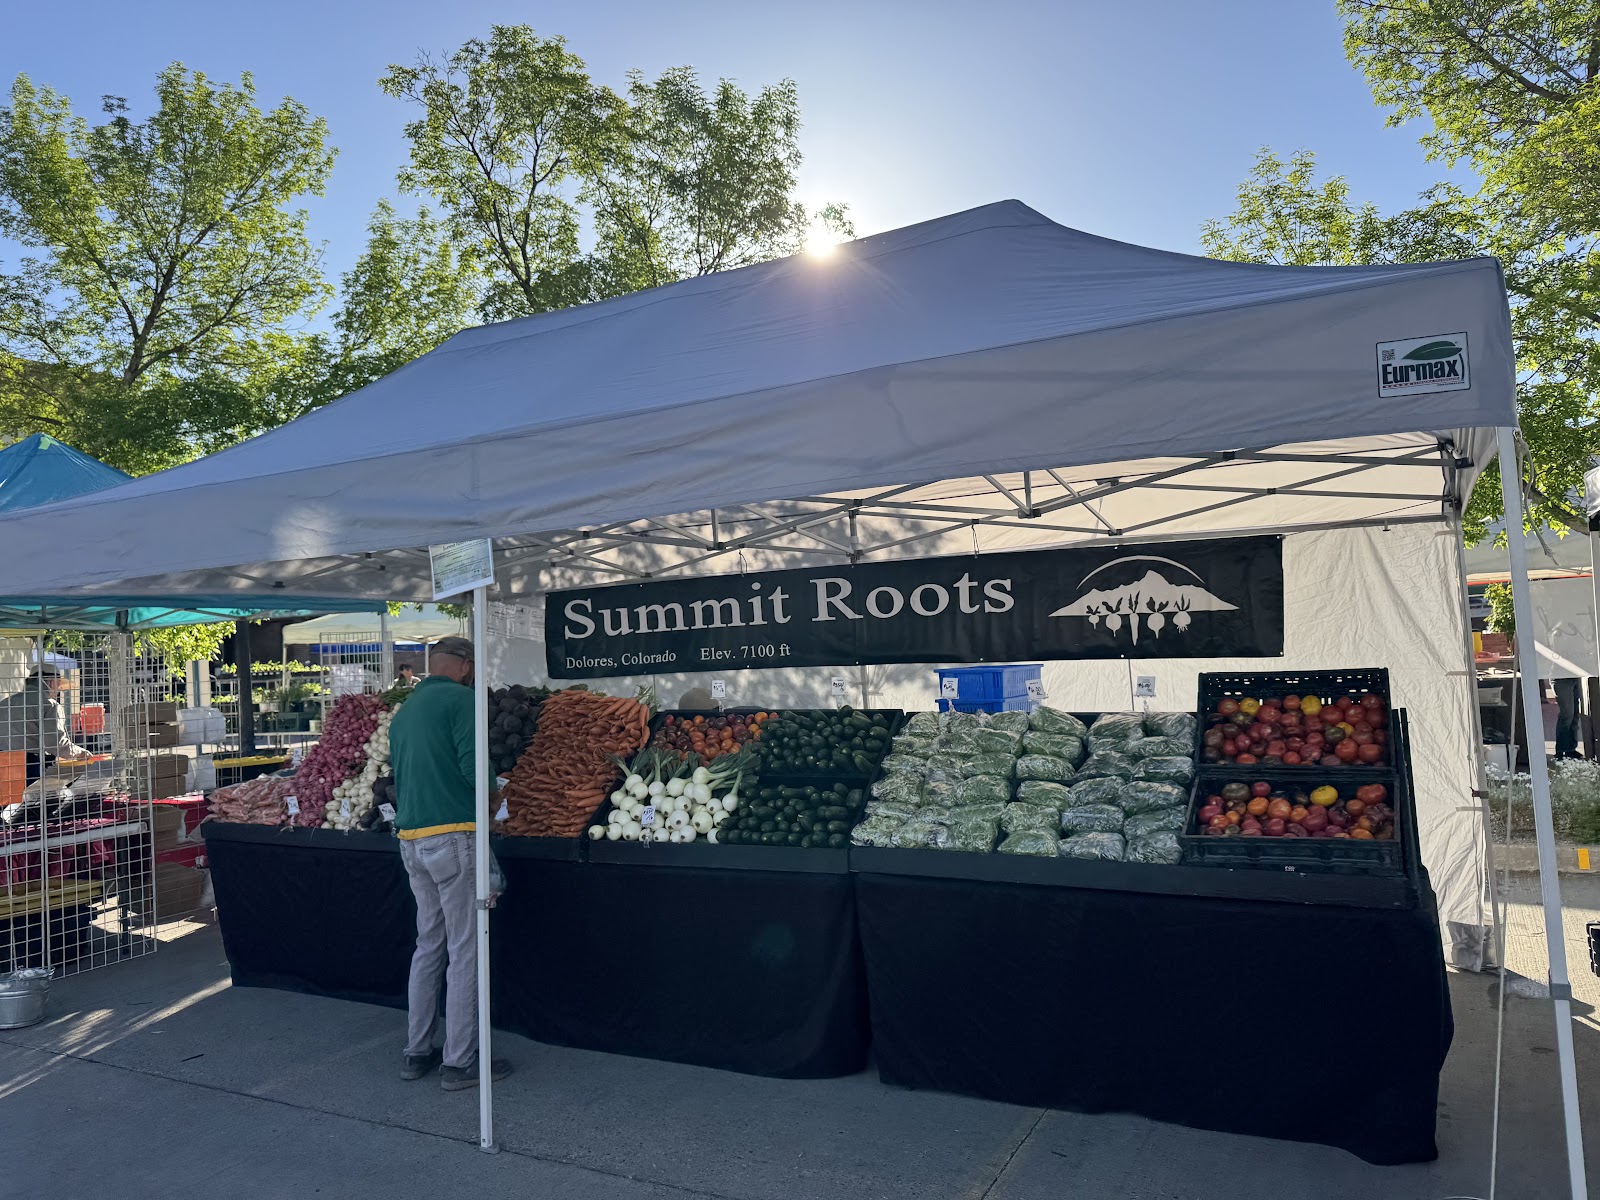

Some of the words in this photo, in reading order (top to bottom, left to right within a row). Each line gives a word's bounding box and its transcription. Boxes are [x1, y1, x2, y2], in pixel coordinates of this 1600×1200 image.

[1382, 359, 1459, 385] Eurmax
[563, 582, 792, 640] Summit
[809, 572, 1015, 622] Roots
[565, 656, 618, 669] Dolores,
[621, 650, 677, 666] Colorado
[700, 646, 736, 661] Elev.
[740, 644, 775, 659] 7100
[778, 643, 791, 657] ft
